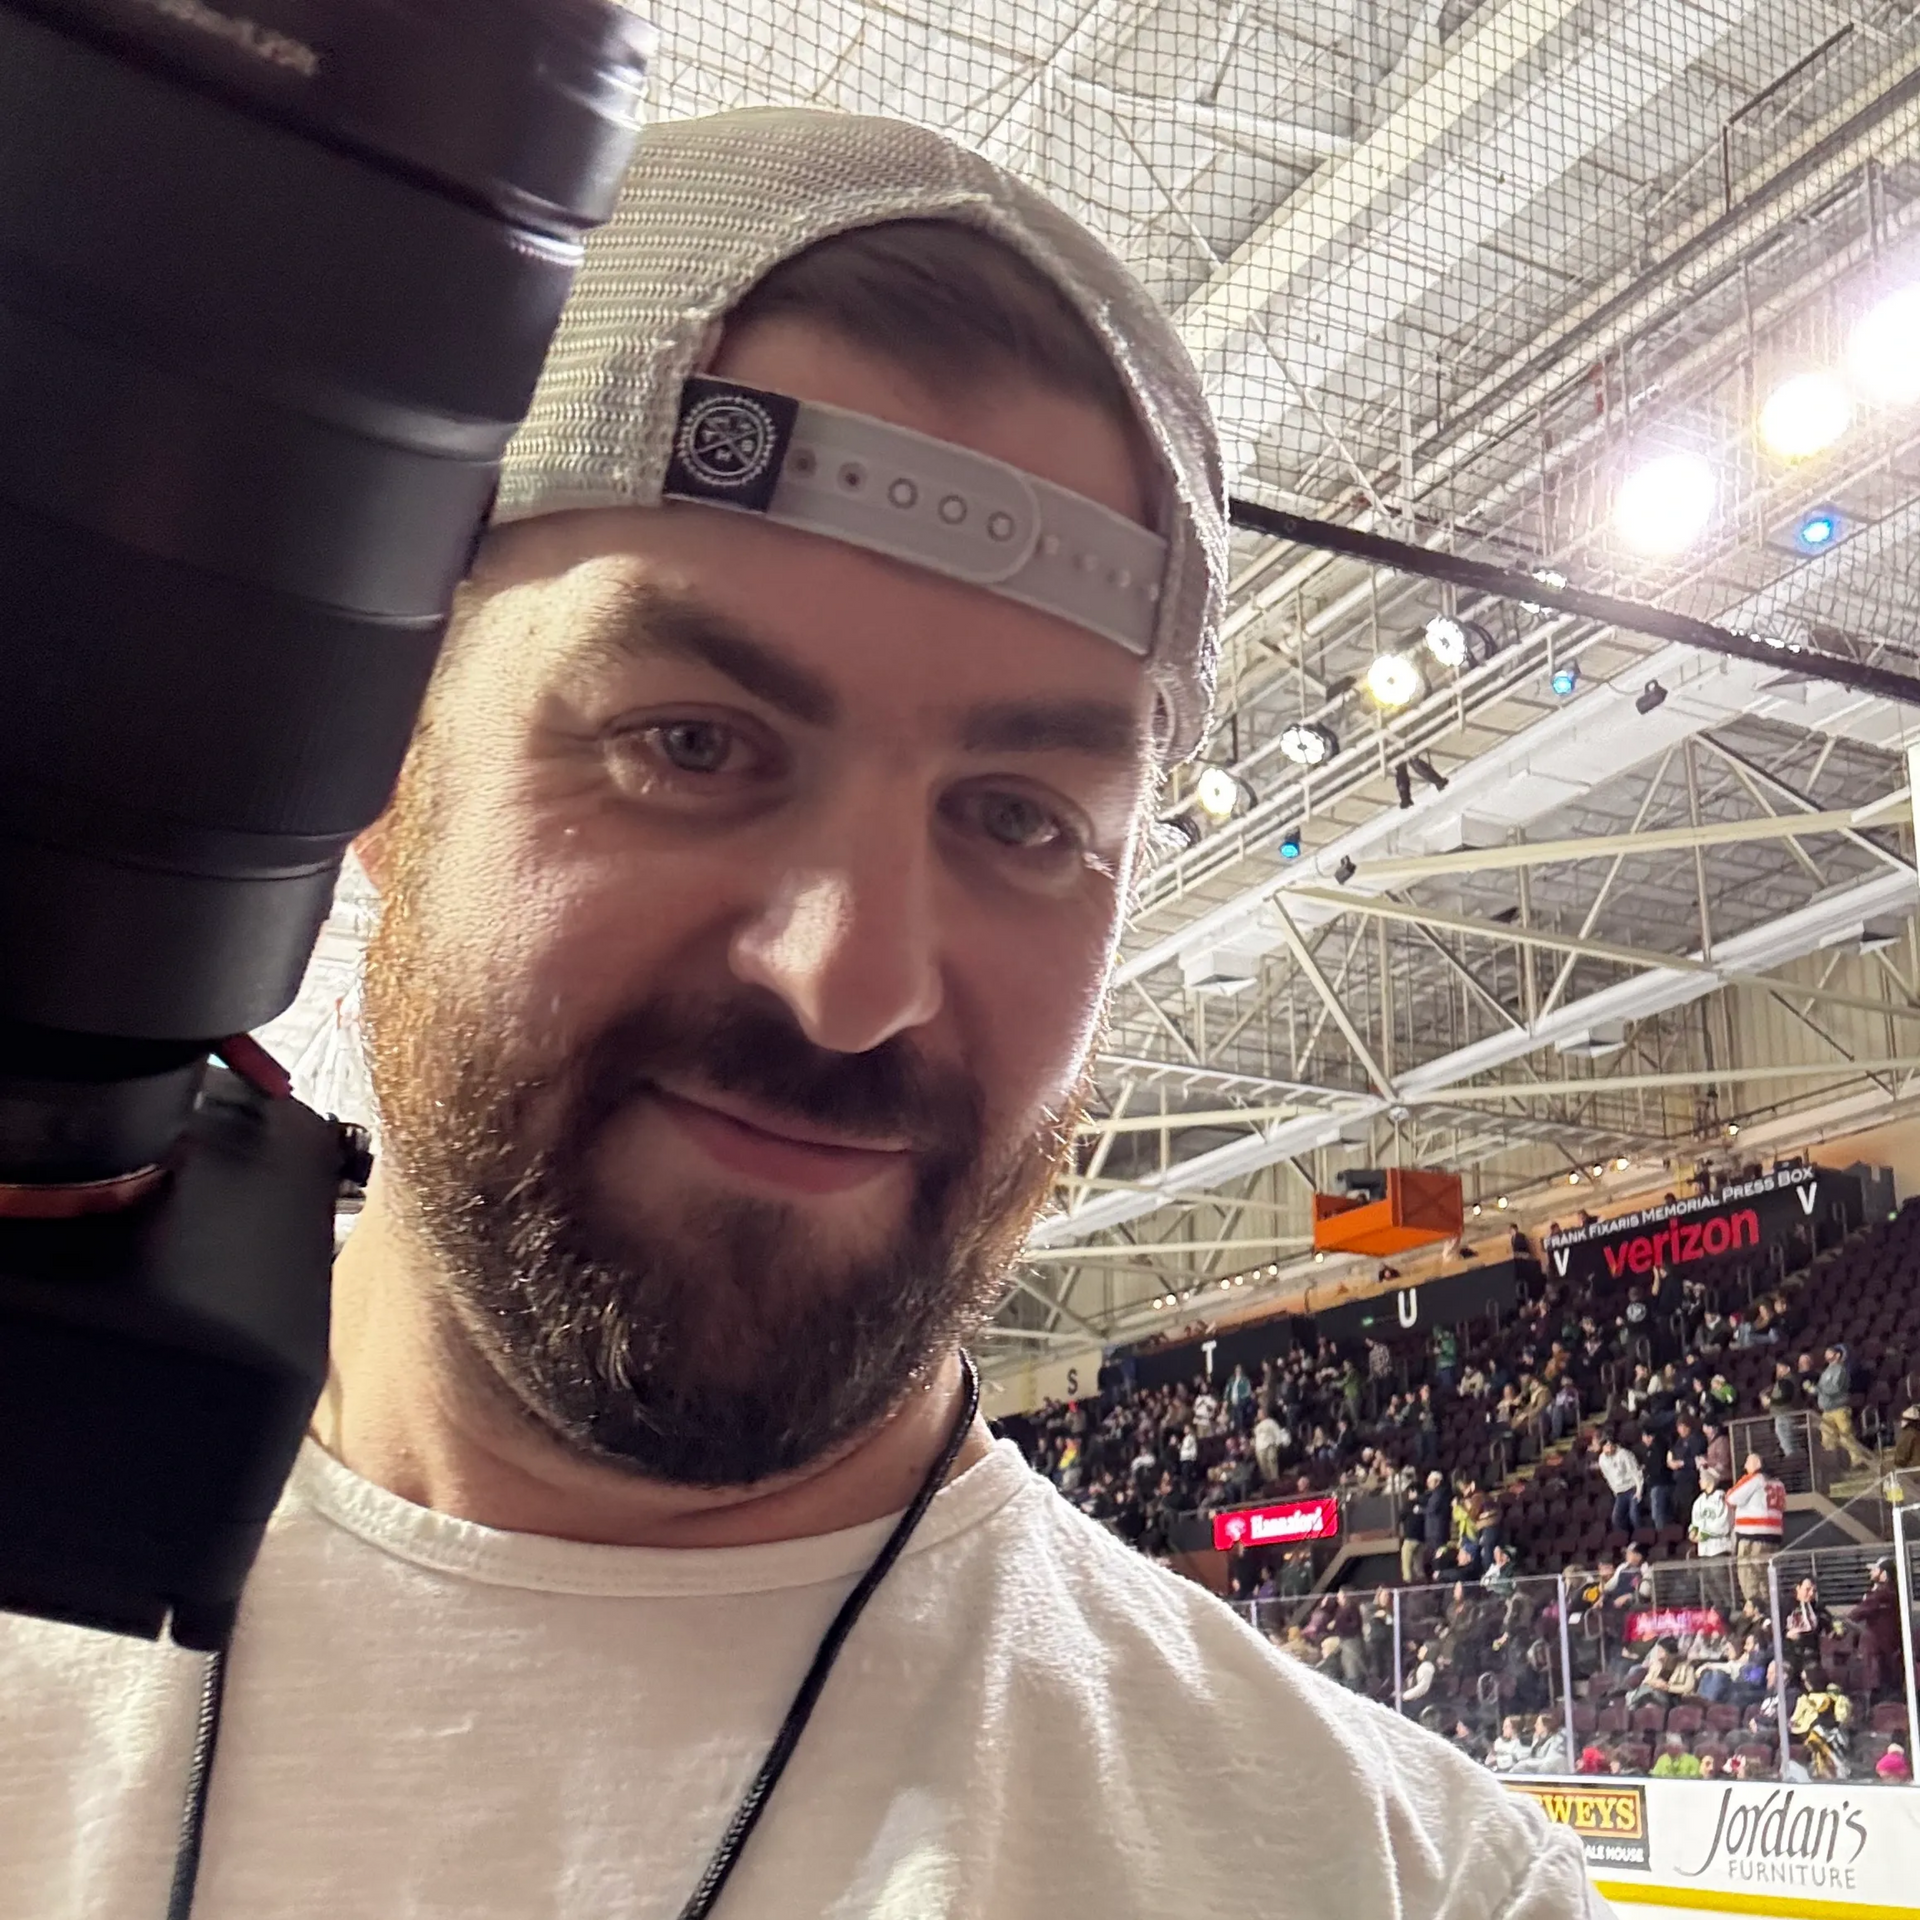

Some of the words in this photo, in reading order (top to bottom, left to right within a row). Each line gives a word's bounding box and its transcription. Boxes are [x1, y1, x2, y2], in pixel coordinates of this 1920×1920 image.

[1543, 1229, 1587, 1251] FRANK
[1589, 1214, 1639, 1239] FIXARIS
[1642, 1194, 1720, 1223] MEMORIAL
[1722, 1177, 1774, 1203] PRESS
[1777, 1166, 1814, 1188] BOX
[1796, 1181, 1817, 1215] V
[1603, 1208, 1759, 1279] verizon
[1553, 1247, 1570, 1277] V
[1398, 1287, 1418, 1328] U
[1202, 1340, 1217, 1375] T
[1067, 1368, 1078, 1395] S
[1533, 1794, 1636, 1831] WEYS
[1673, 1787, 1868, 1877] Jordan's
[1606, 1848, 1645, 1863] HOUSE
[1728, 1859, 1857, 1890] FURNITURE
